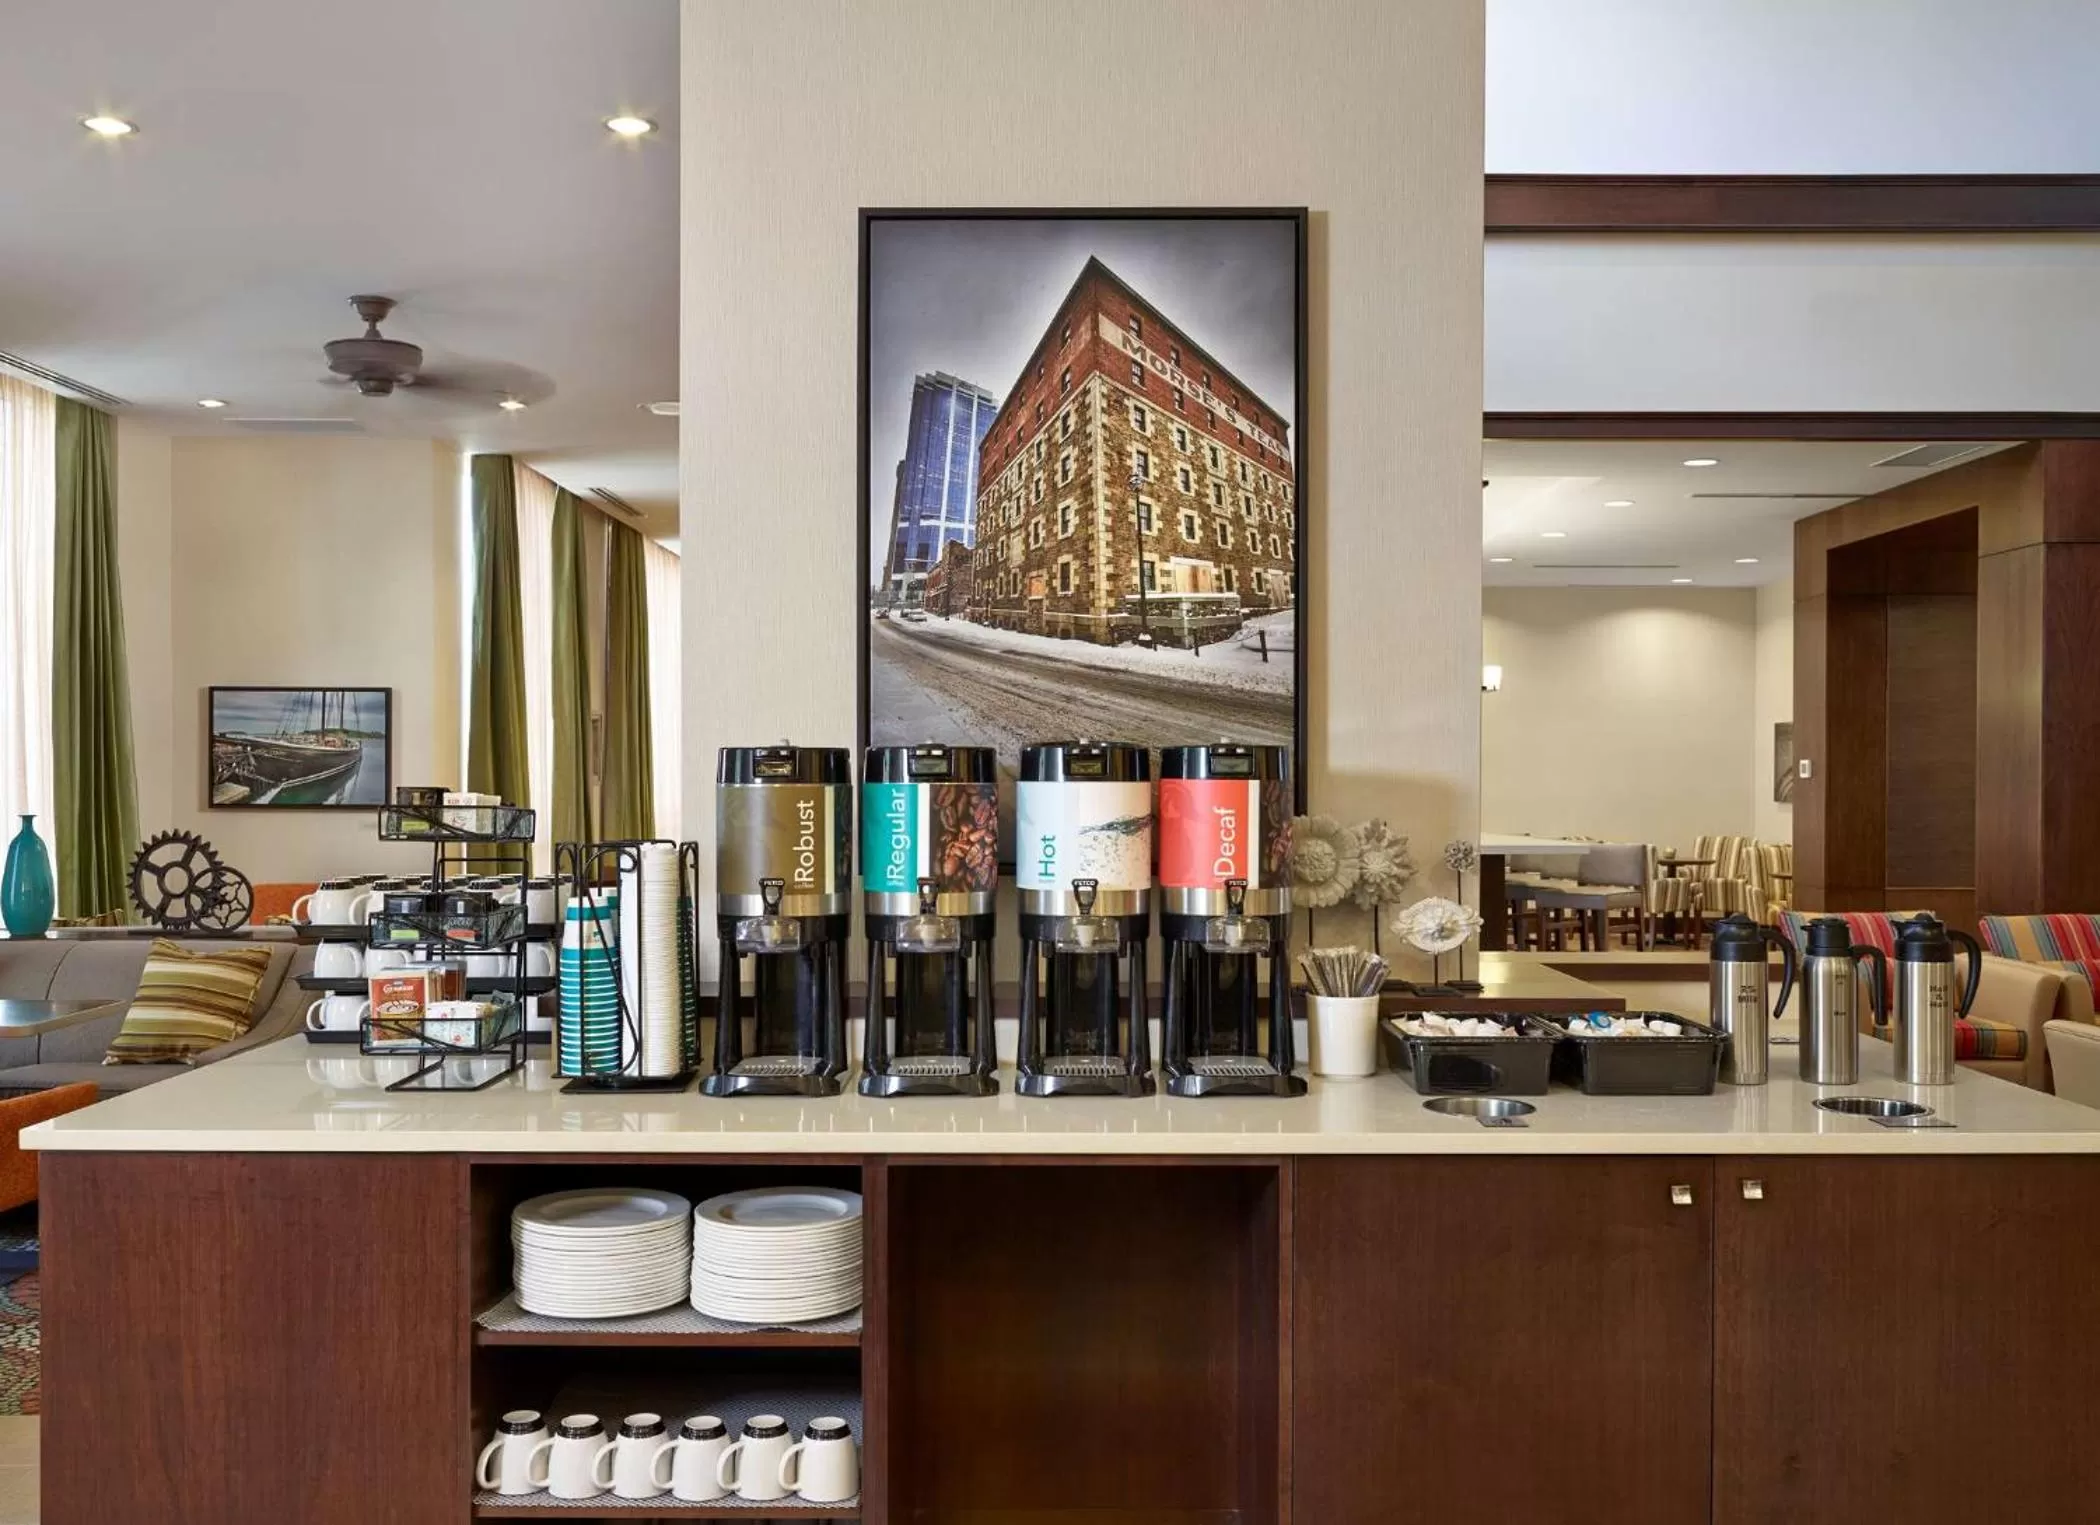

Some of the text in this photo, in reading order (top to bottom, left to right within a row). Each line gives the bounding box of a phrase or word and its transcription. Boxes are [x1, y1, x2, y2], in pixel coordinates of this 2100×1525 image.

[1121, 332, 1238, 425] MORSE'S
[792, 800, 815, 882] Robust
[886, 788, 911, 879] Regular
[1038, 835, 1056, 877] Hot
[1212, 806, 1236, 877] Decaf
